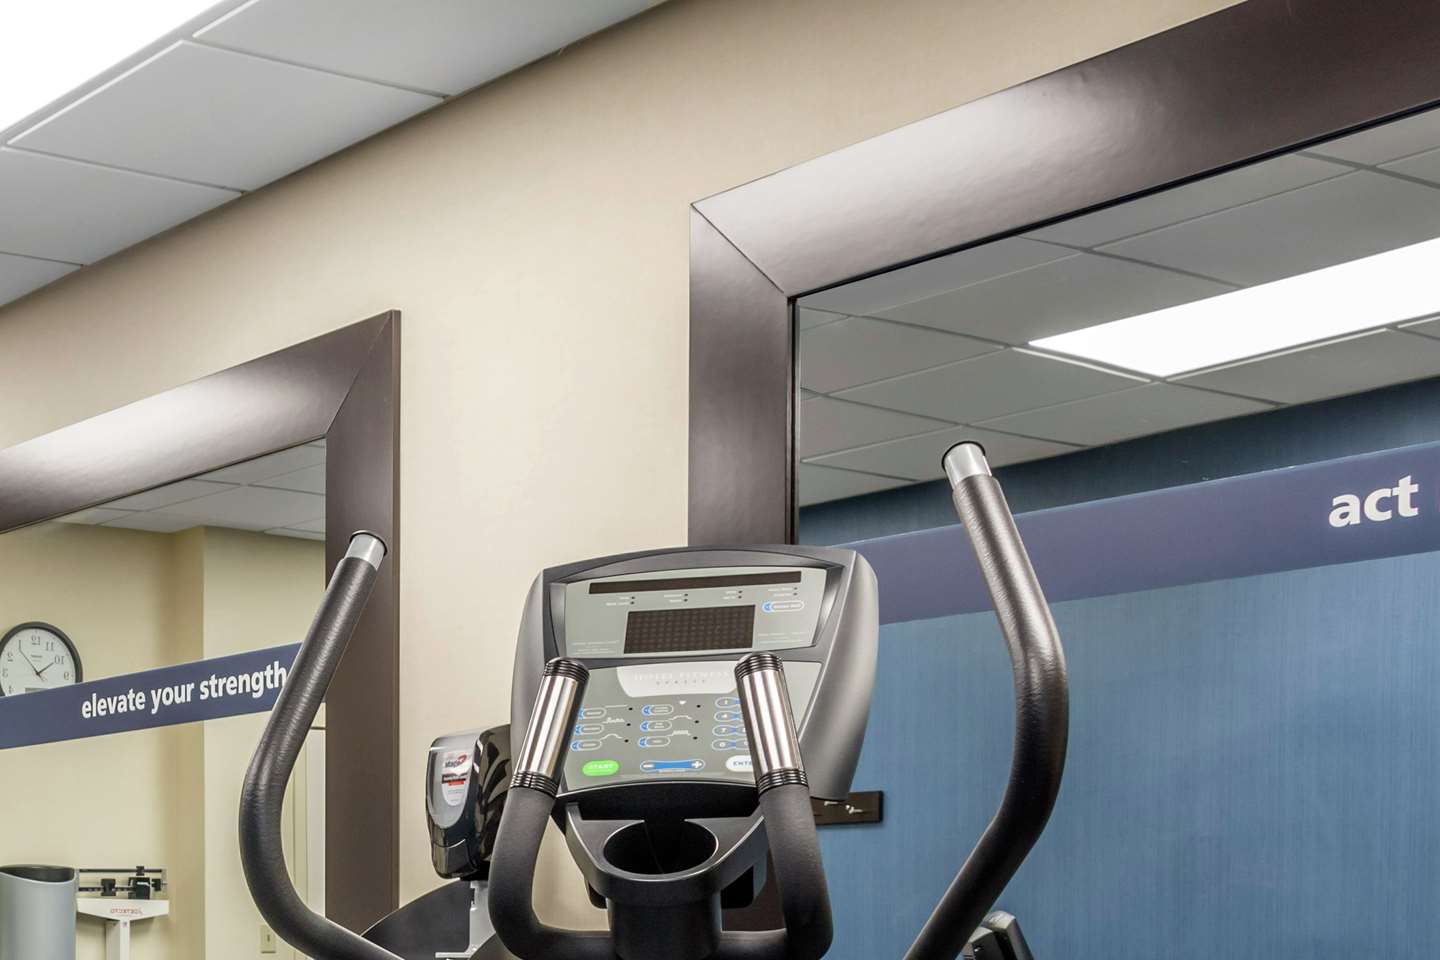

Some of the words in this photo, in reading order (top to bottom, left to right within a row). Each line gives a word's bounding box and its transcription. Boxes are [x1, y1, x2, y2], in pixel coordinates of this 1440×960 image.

[1329, 475, 1419, 528] act
[81, 688, 145, 719] elevate
[151, 682, 195, 715] your
[199, 660, 288, 699] strength
